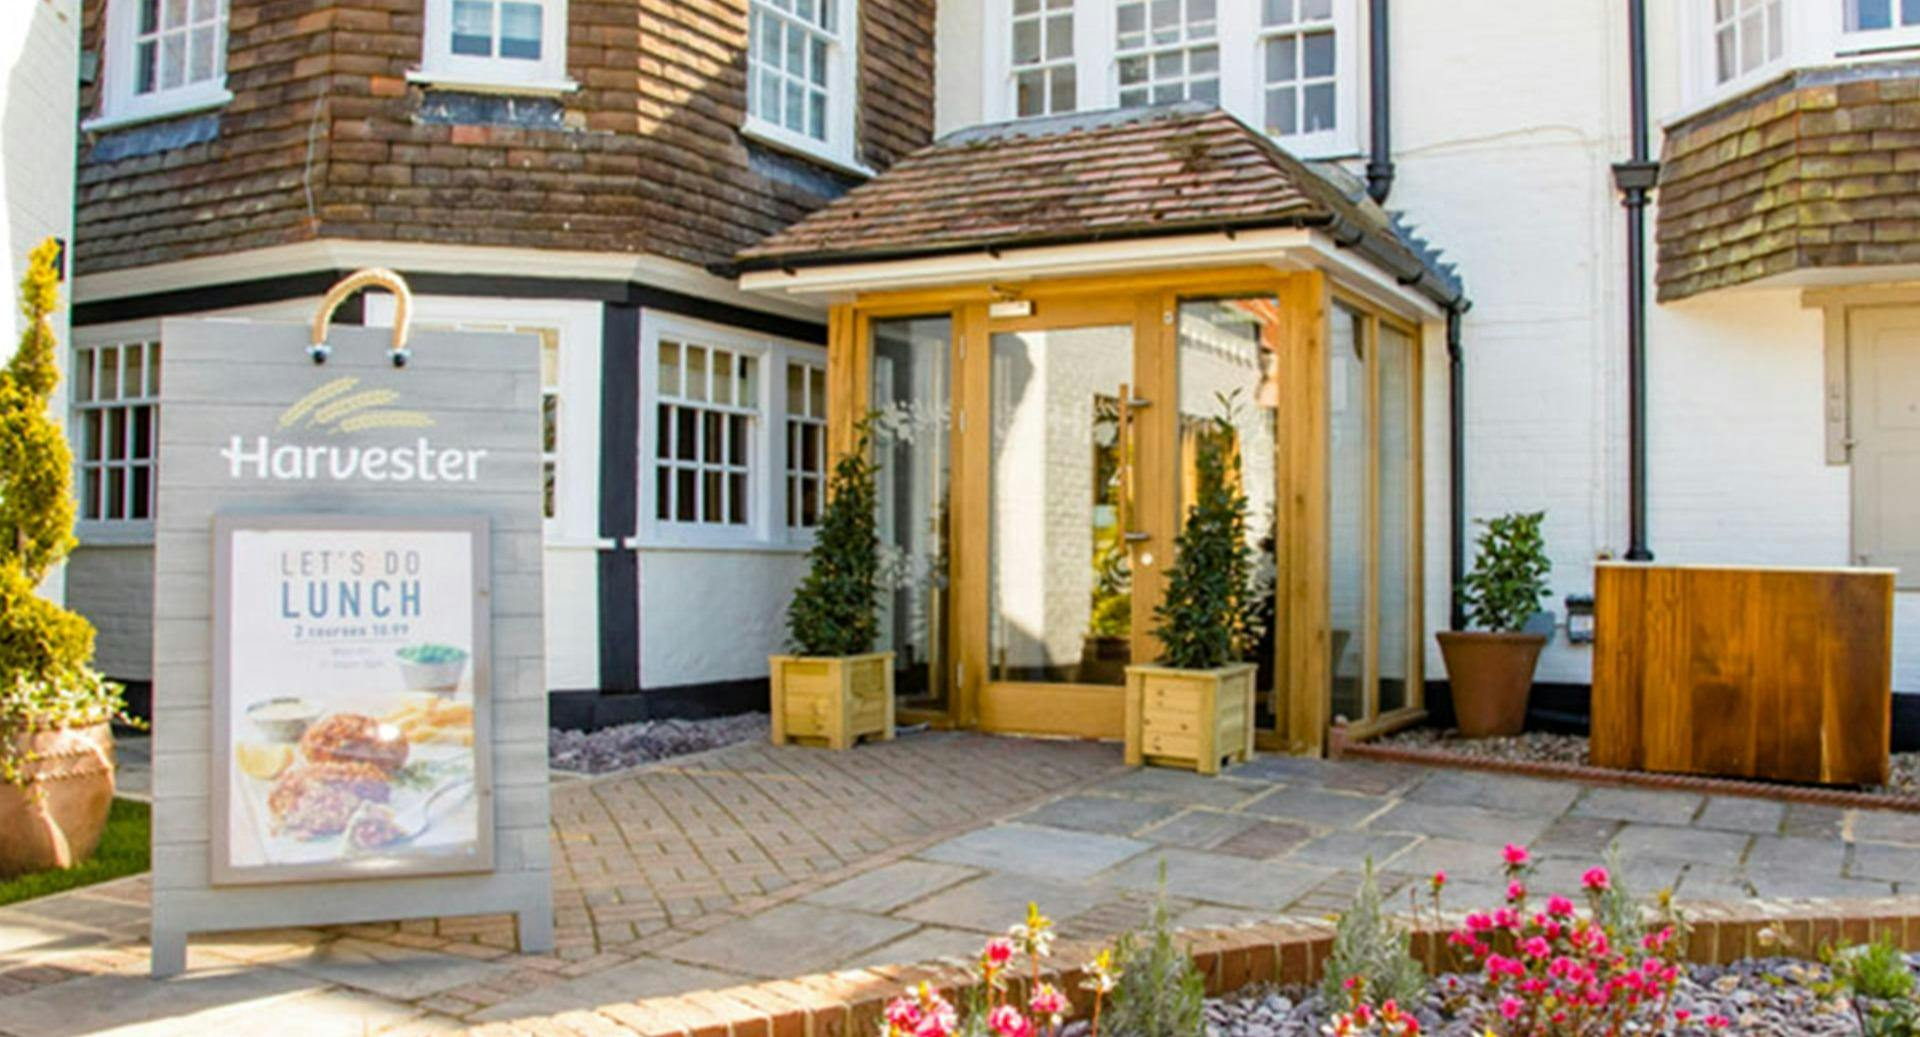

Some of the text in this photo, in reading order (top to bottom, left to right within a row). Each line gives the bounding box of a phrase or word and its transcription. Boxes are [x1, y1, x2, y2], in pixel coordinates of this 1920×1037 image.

[220, 435, 488, 481] Harvester
[281, 550, 420, 576] LET'S DO
[281, 580, 421, 618] LUNCH
